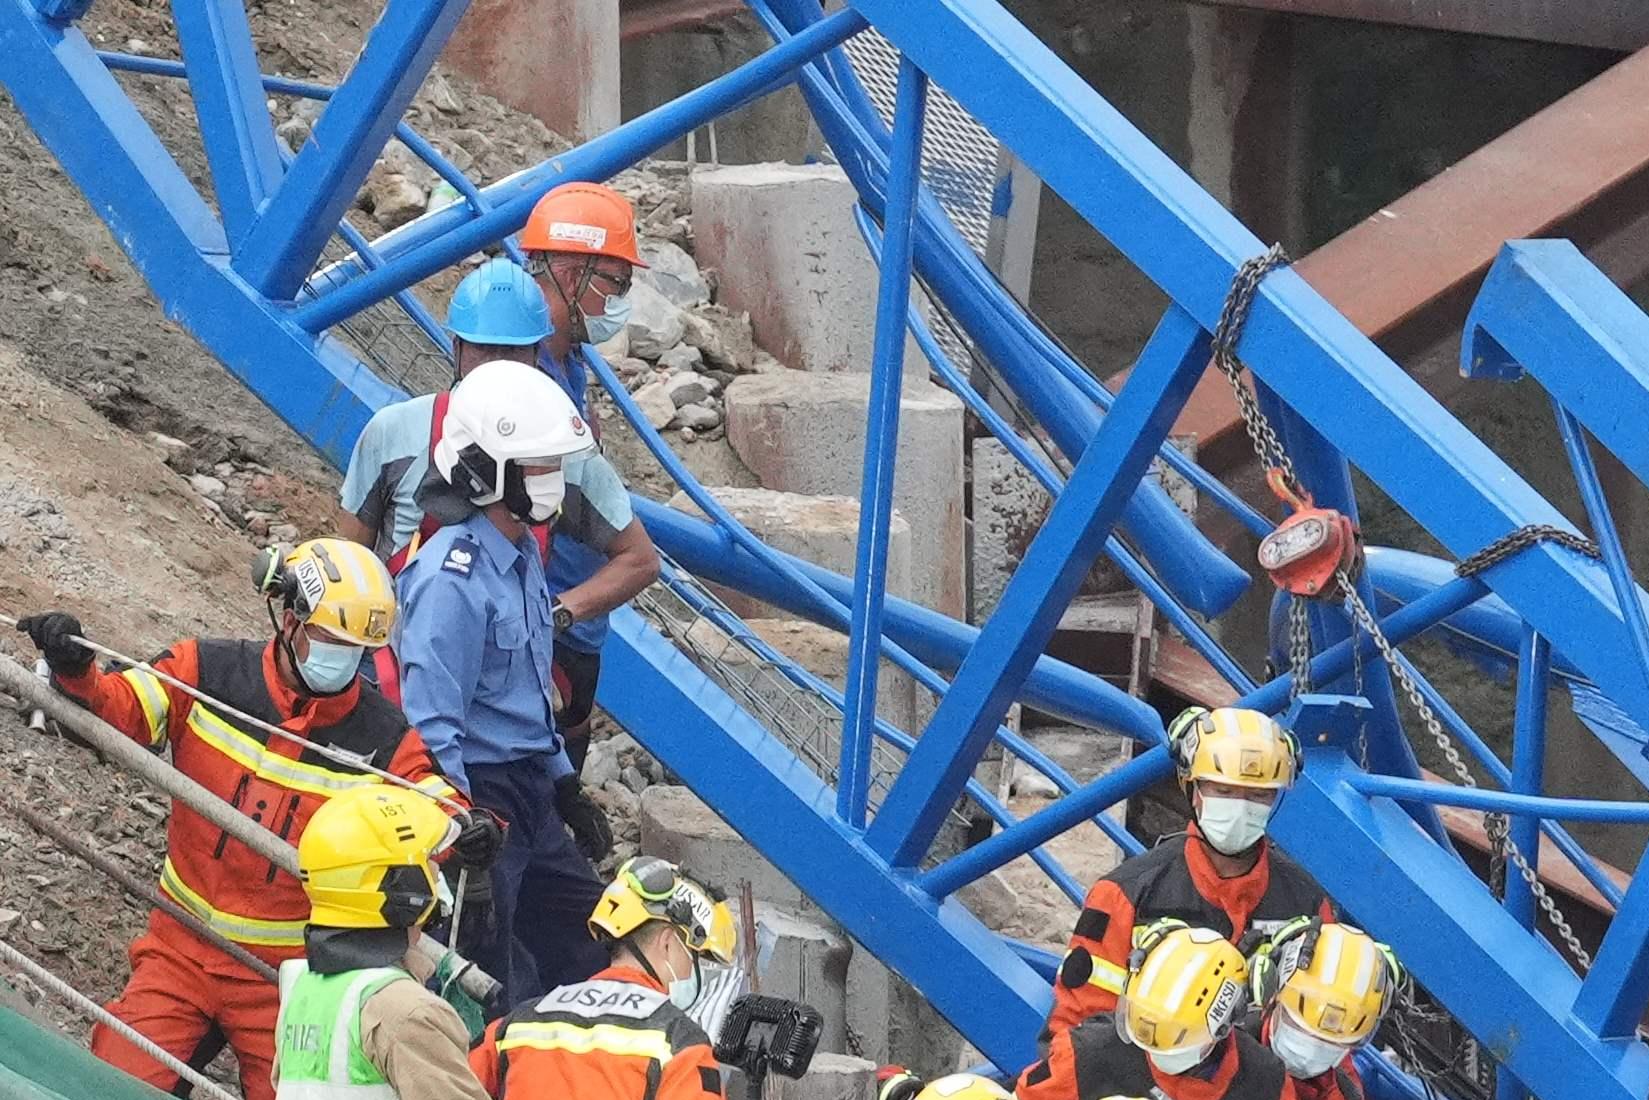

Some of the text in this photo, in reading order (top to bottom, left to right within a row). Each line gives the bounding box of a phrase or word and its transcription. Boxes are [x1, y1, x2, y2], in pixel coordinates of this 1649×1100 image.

[299, 559, 322, 598] USAR
[675, 884, 712, 921] USAR
[556, 987, 646, 1010] USAR
[1209, 981, 1237, 1022] HKFSD
